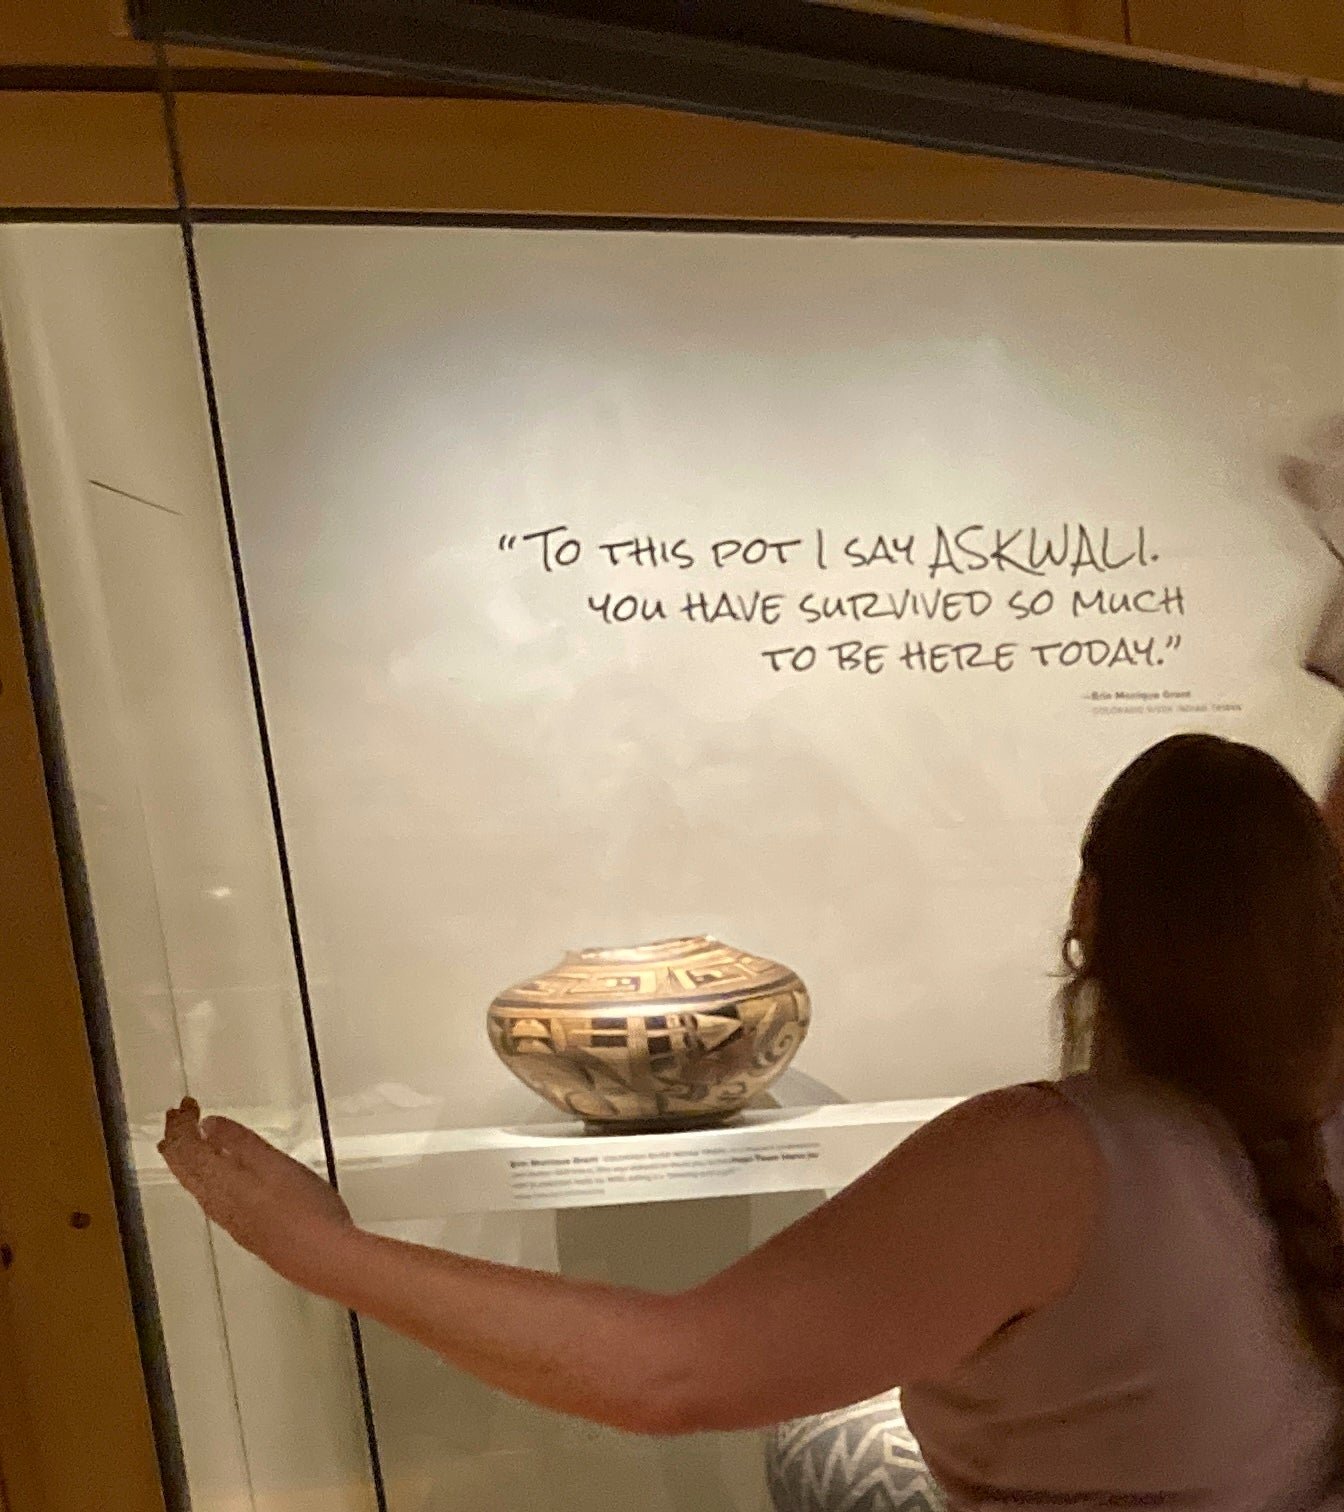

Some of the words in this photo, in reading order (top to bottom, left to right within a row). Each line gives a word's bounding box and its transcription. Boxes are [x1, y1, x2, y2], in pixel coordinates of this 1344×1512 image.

[599, 536, 694, 569] THIS
[711, 538, 801, 567] POT
[817, 529, 827, 569] I
[844, 534, 915, 568] SAY
[928, 523, 1160, 579] ASKWALI.
[587, 593, 667, 624] YOU
[680, 590, 784, 624] HAVE
[799, 588, 993, 623] SURVIVED
[1008, 589, 1054, 620] SO
[1072, 586, 1185, 618] MUCH
[761, 646, 816, 671] TO
[828, 640, 889, 674] BE
[899, 640, 1018, 673] HERE
